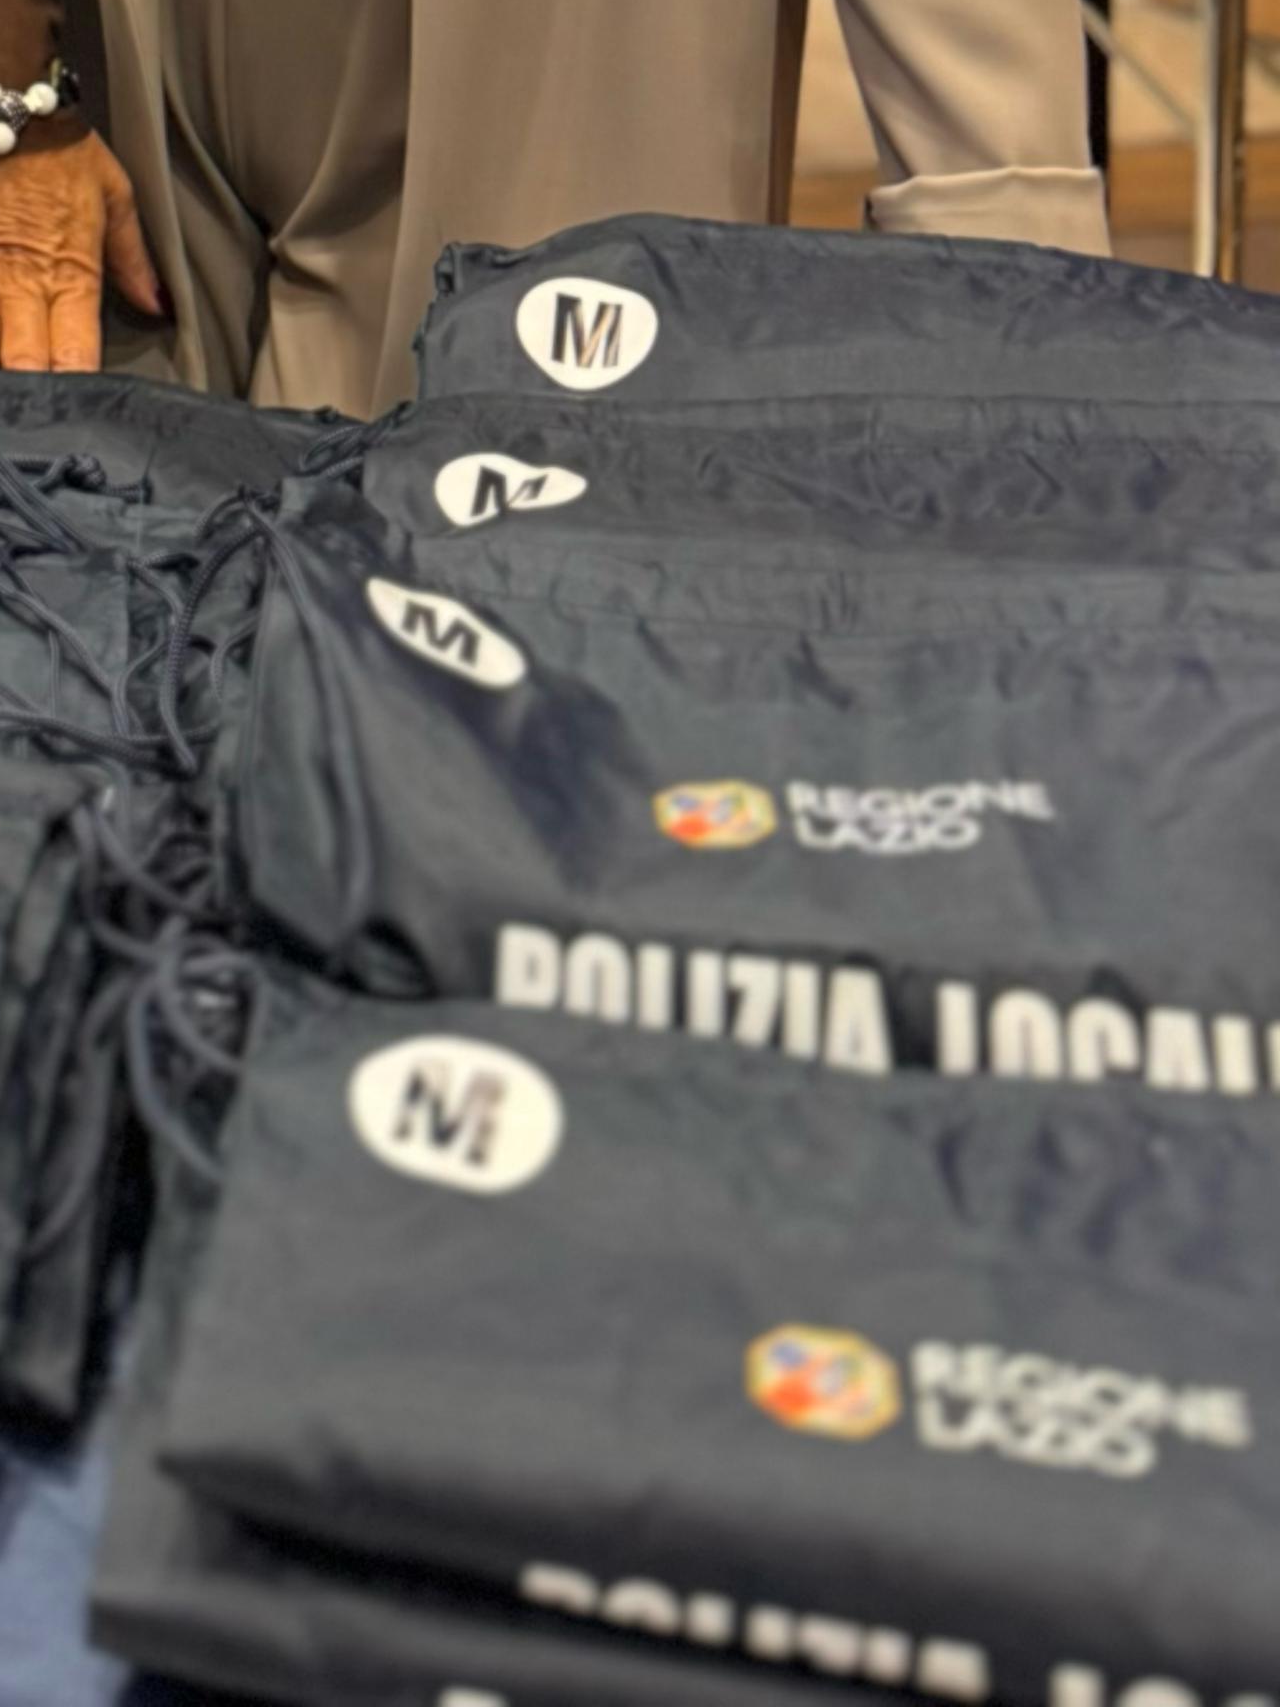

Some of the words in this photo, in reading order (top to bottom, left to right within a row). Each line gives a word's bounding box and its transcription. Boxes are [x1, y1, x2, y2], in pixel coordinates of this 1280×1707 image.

[551, 292, 623, 369] M
[401, 599, 481, 667] M
[785, 780, 1055, 821] REGIONE
[793, 813, 981, 855] LAZIO
[938, 982, 1280, 1094] LOCAL
[391, 1062, 509, 1169] M
[911, 1340, 1251, 1449] REGIONE
[916, 1390, 1158, 1479] LAZIO
